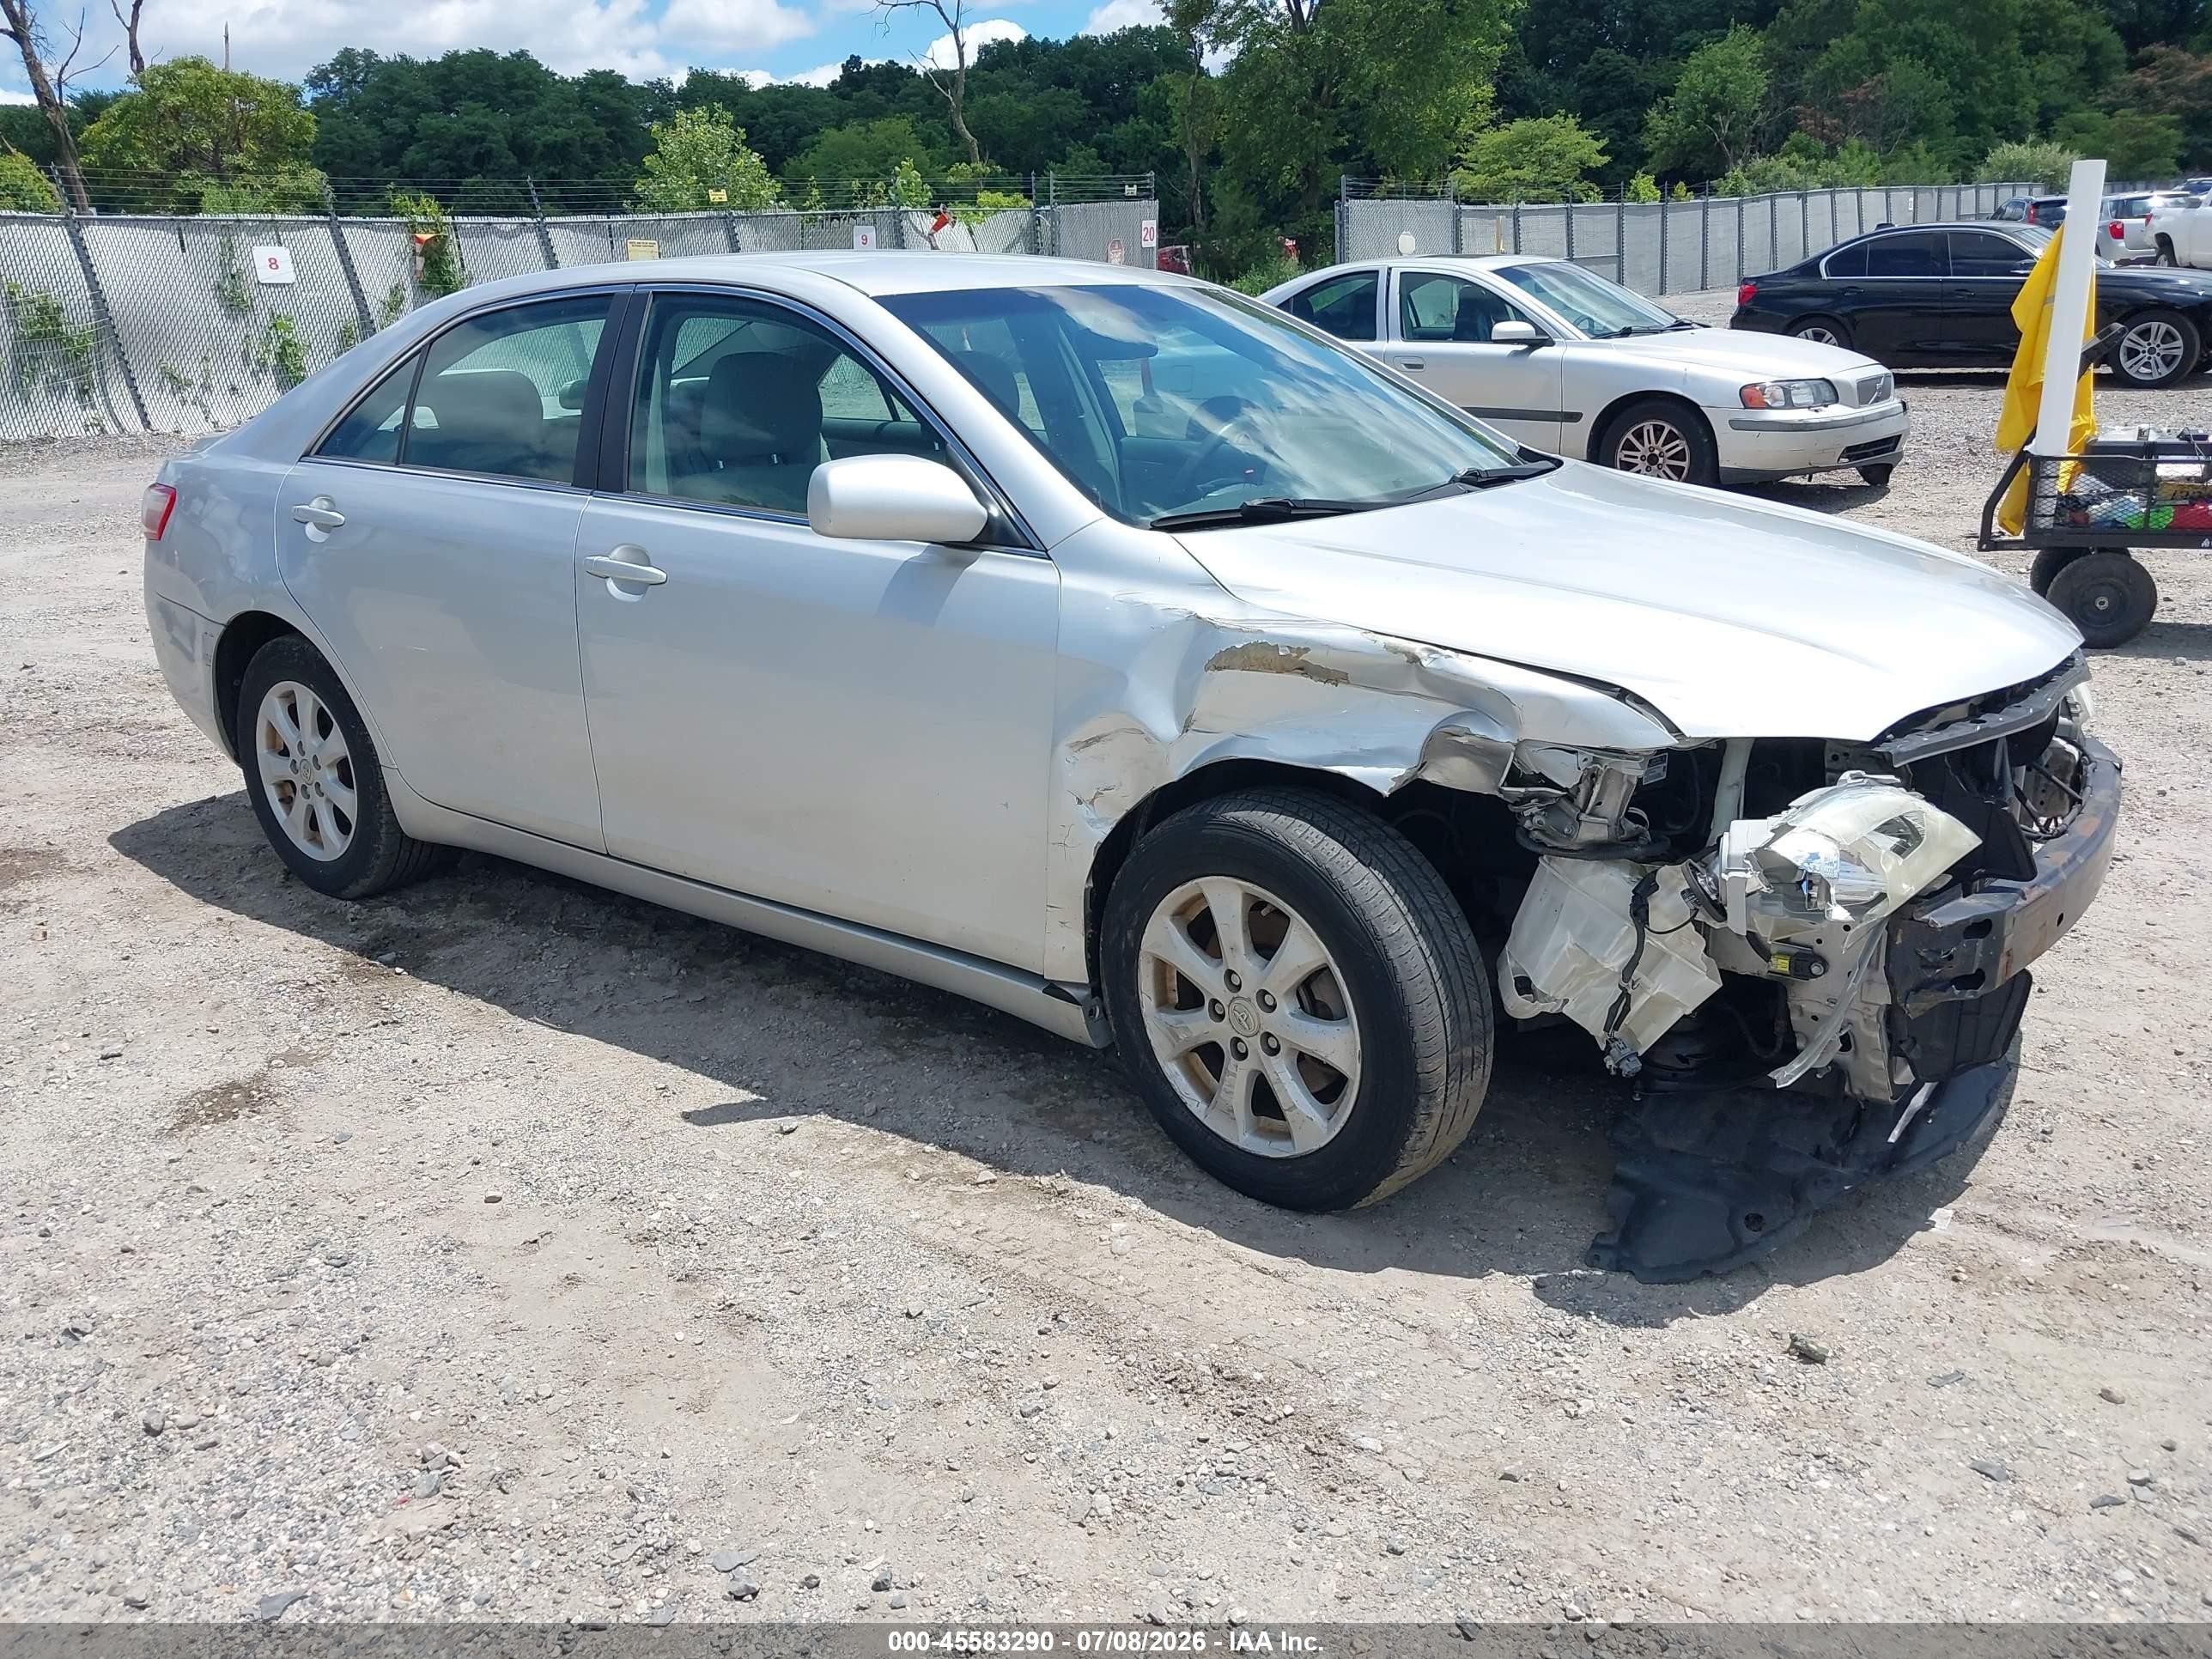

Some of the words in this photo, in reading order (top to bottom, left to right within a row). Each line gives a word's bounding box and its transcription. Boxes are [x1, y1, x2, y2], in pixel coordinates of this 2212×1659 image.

[860, 234, 868, 246] 9
[1143, 226, 1155, 242] 20
[268, 257, 279, 270] 8
